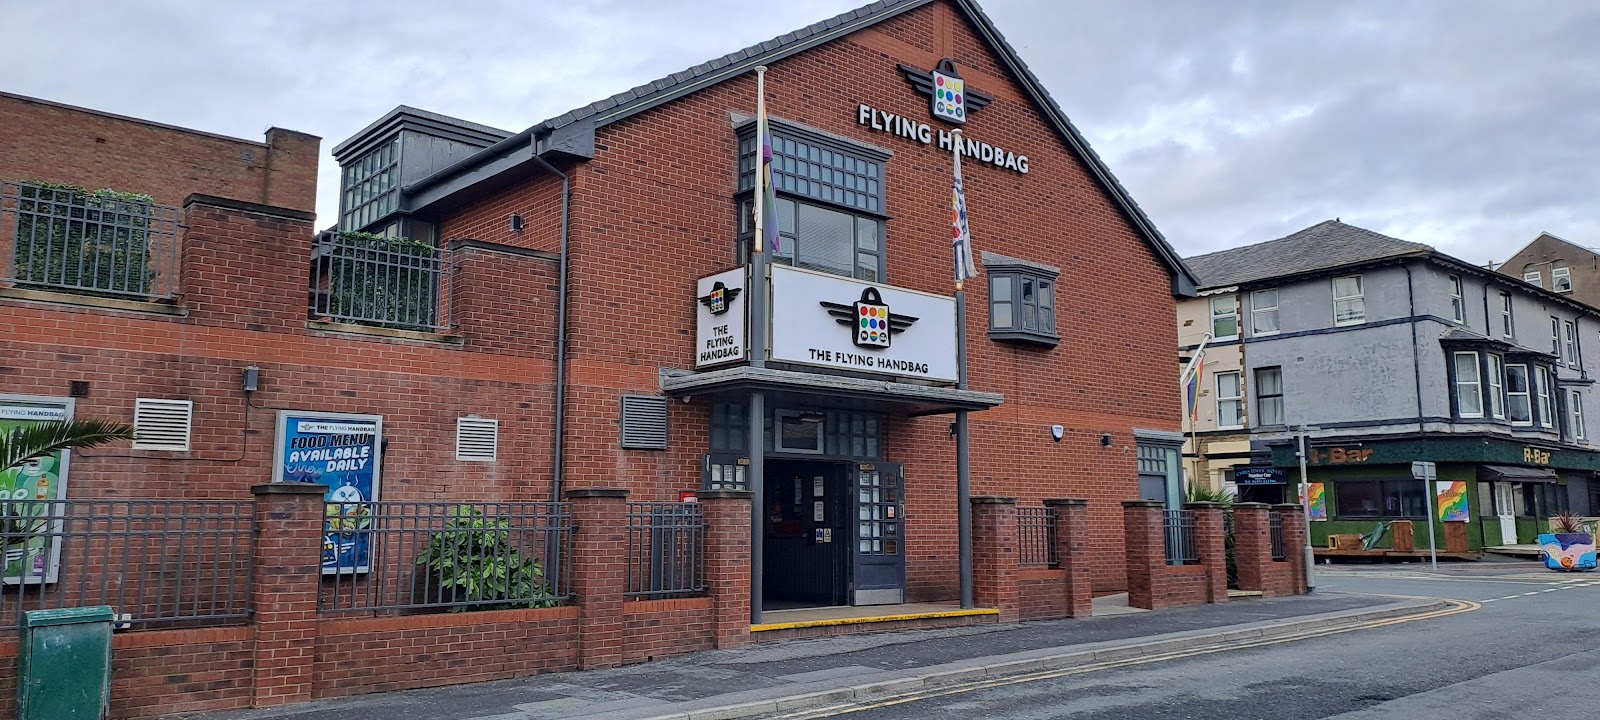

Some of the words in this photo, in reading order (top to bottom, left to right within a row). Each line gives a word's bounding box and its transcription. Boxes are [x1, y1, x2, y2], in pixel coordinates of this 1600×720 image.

[859, 103, 932, 144] FLYING
[937, 129, 1030, 174] HANDBAG
[713, 325, 729, 336] THE
[706, 336, 734, 350] FLYING
[700, 346, 740, 362] HANDBAG
[809, 348, 832, 362] THE
[835, 353, 874, 367] FLYING
[877, 357, 929, 374] HANDBAG
[27, 410, 65, 418] HANDBAG
[291, 435, 327, 449] FOOD
[330, 433, 369, 447] MENU
[289, 446, 370, 463] AVAILABLE
[1524, 448, 1551, 464] R-Bar
[326, 458, 368, 472] DAILY
